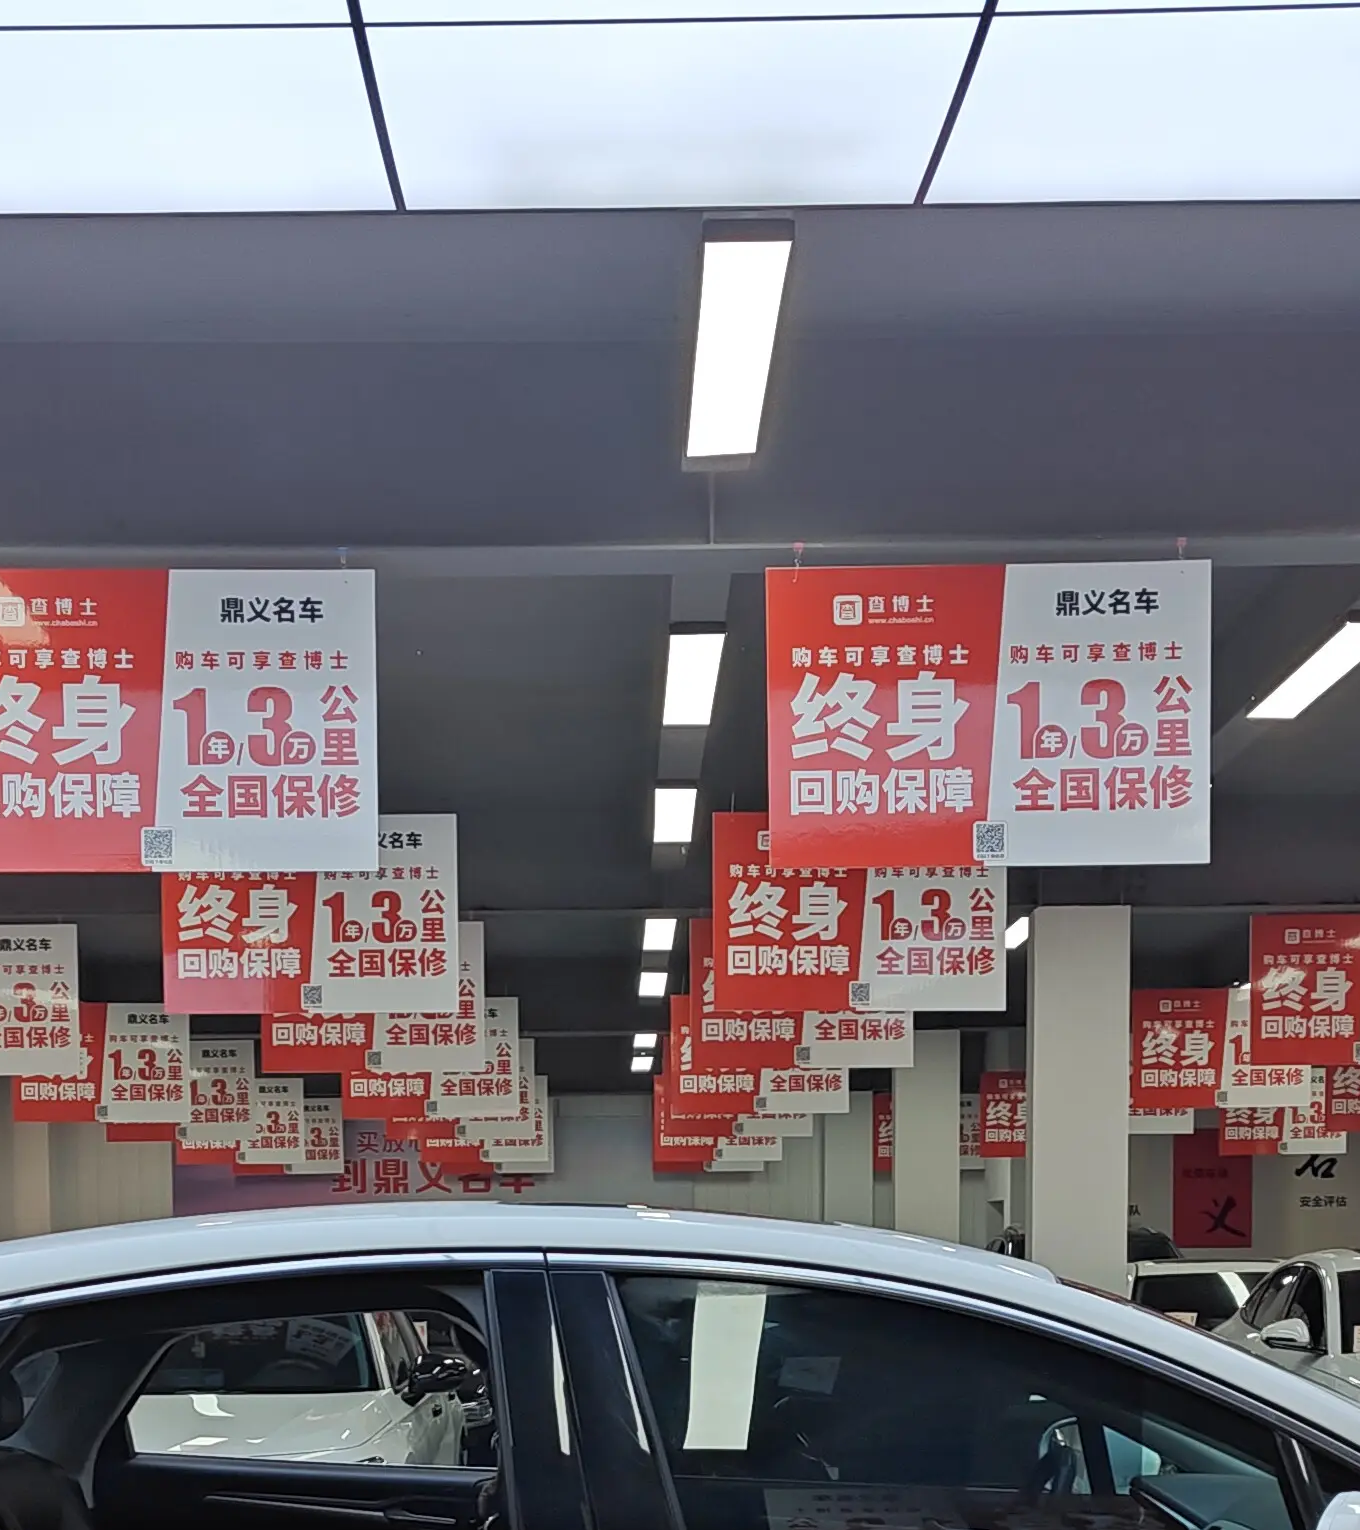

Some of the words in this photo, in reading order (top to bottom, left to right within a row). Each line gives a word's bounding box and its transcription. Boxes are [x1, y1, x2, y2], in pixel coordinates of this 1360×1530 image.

[30, 598, 97, 615] 查博士
[220, 597, 324, 624] 鼎义名车
[867, 595, 934, 612] 查博士
[1055, 587, 1160, 617] 鼎义名车
[175, 651, 349, 671] 购车可享查博士
[791, 645, 970, 667] 购车可享查博士
[1010, 641, 1183, 665] 购车可享查博士
[790, 671, 970, 761] 终身
[180, 774, 361, 819] 全国保修
[790, 767, 974, 816] 回购保障
[1013, 764, 1193, 812] 全国保修
[874, 867, 989, 878] 购车可享查博士
[178, 884, 298, 944] 终身
[728, 881, 848, 941] 终身
[0, 939, 52, 951] 鼎义名车
[177, 948, 302, 979] 回购保障
[327, 948, 447, 978] 全国保修
[727, 945, 850, 976] 回购保障
[876, 946, 996, 976] 全国保修
[1262, 967, 1353, 1013] 终身
[128, 1014, 169, 1025] 鼎义名车
[701, 1019, 795, 1042] 回购保障
[815, 1019, 905, 1041] 全国保修
[1261, 1015, 1354, 1039] 回购保障
[272, 1023, 366, 1046] 回购保障
[386, 1024, 476, 1046] 全国保修
[1142, 1030, 1215, 1066] 终身
[351, 1078, 425, 1098] 回购保障
[441, 1079, 512, 1097] 全国保修
[680, 1074, 754, 1094] 回购保障
[770, 1074, 842, 1092] 全国保修
[1141, 1068, 1216, 1088] 回购保障
[1231, 1068, 1304, 1086] 全国保修
[21, 1082, 96, 1102] 回购保障
[111, 1084, 183, 1101] 全国保修
[191, 1108, 251, 1123] 全国保修
[1225, 1127, 1280, 1141] 回购保障
[1300, 1196, 1347, 1208] 安全评估
